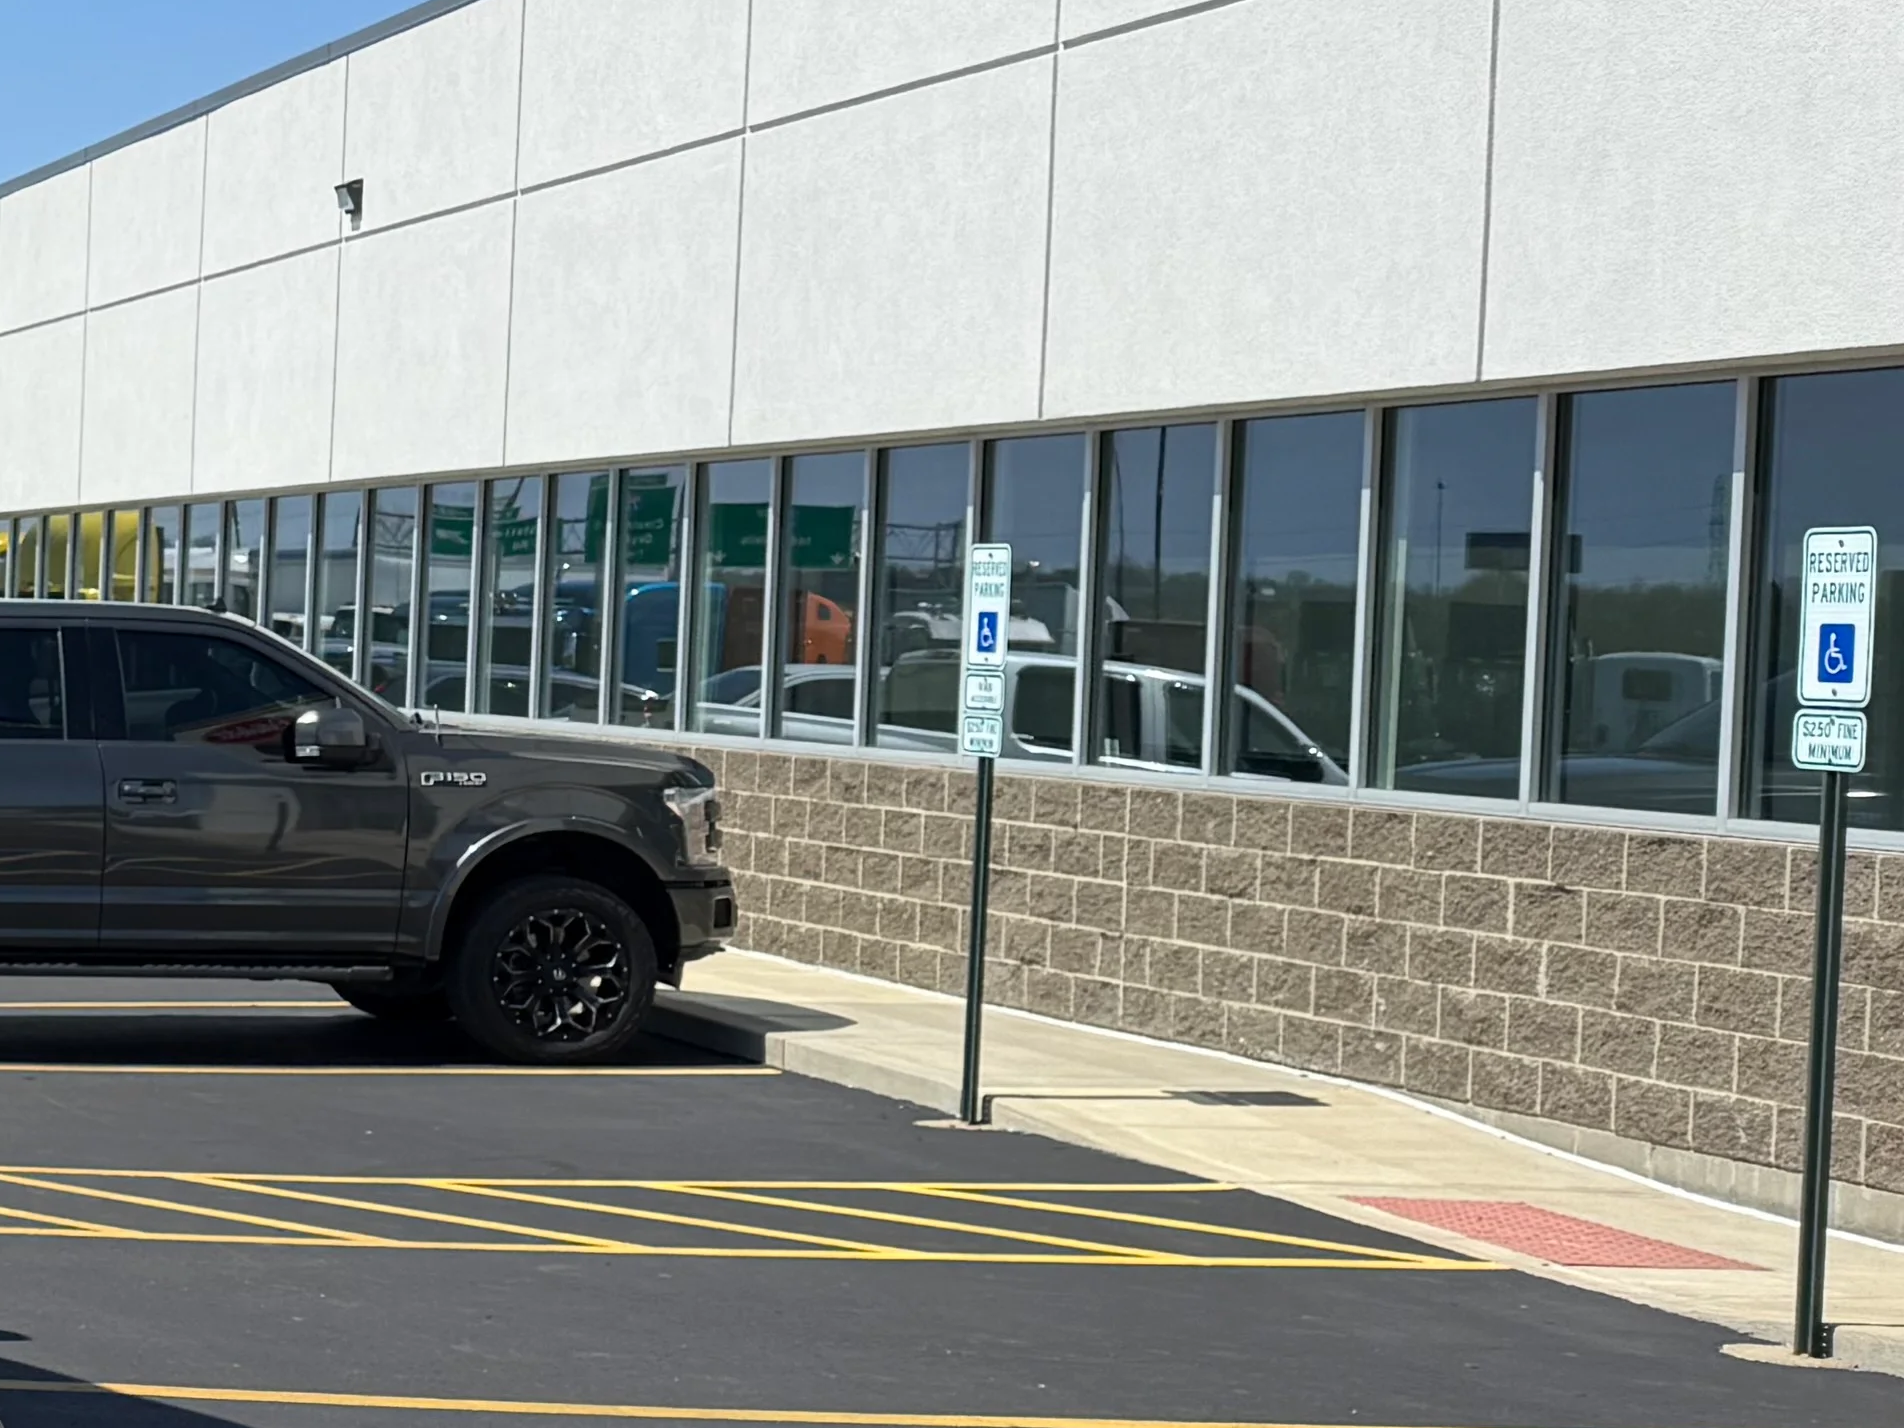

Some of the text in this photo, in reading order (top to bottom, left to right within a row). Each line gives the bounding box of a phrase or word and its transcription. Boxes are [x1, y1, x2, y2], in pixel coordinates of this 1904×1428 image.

[1809, 551, 1870, 574] RESERVED
[1811, 581, 1866, 605] PARKING
[1802, 719, 1859, 741] $250 FINE
[1808, 742, 1853, 762] MINIMUM
